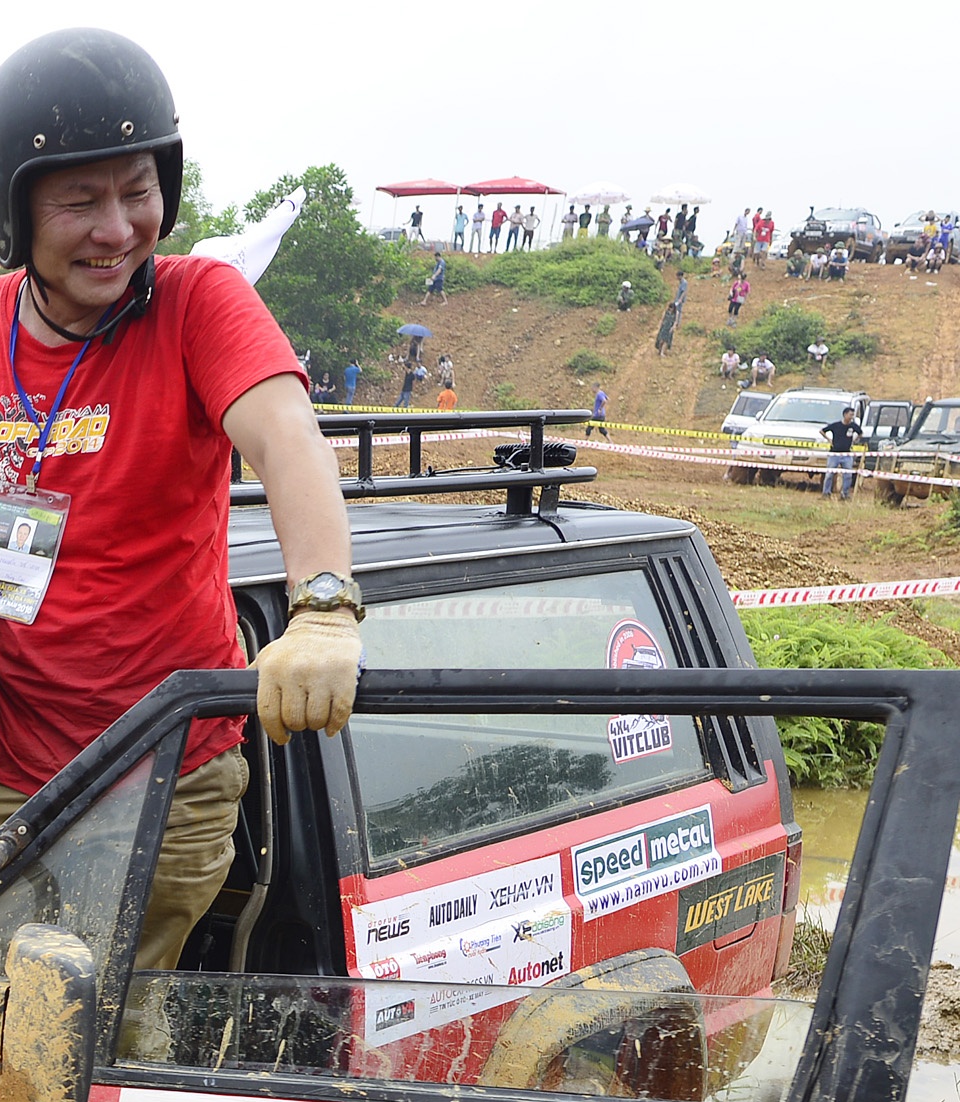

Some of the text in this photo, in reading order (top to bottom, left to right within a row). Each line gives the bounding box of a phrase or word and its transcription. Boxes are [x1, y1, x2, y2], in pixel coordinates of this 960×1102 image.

[26, 436, 105, 458] CP 2014
[580, 822, 711, 885] speed metal
[489, 874, 554, 910] XEHAY.VN
[588, 857, 718, 914] www.namvu.com.vn
[367, 915, 398, 928] OTOFUN
[684, 878, 773, 934] WEST LAKE
[508, 951, 564, 985] Autonet
